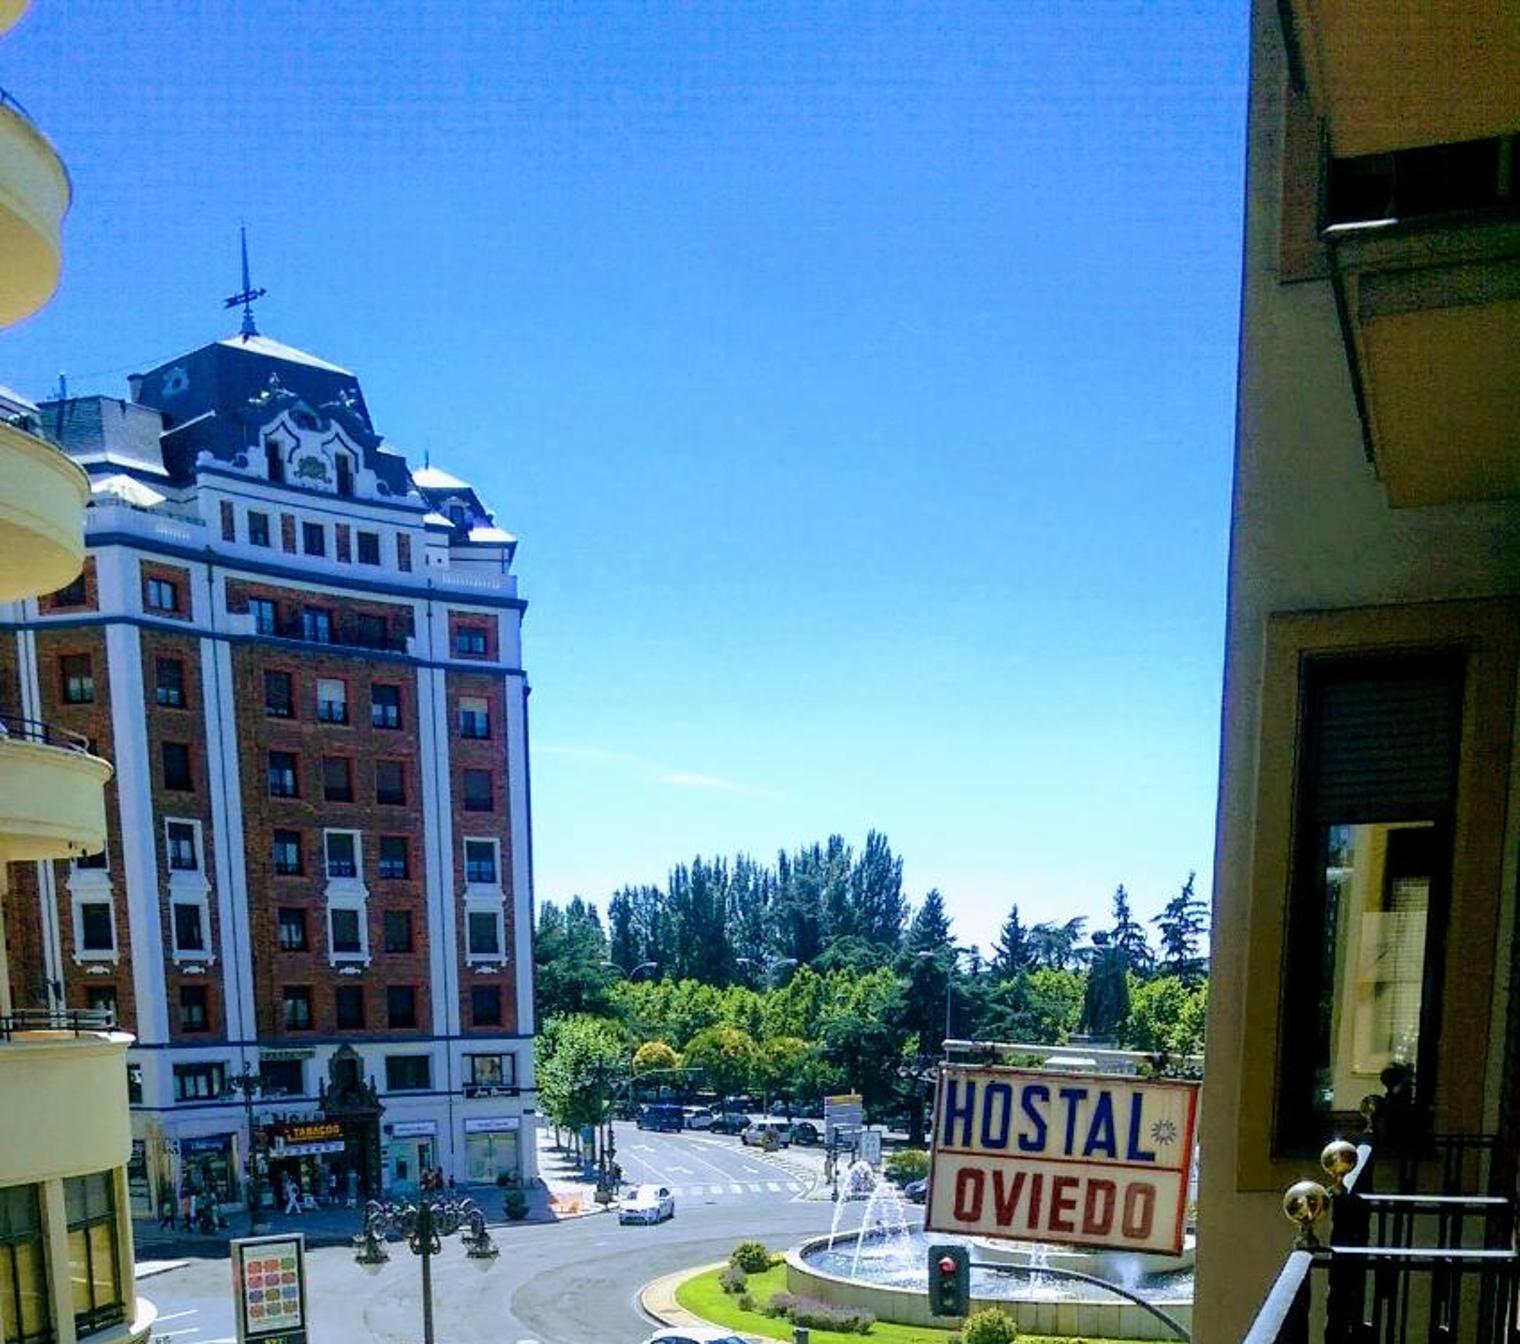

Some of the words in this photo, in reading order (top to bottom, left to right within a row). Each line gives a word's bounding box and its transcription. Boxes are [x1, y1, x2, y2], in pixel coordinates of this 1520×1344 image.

[293, 1124, 340, 1137] TABACOS
[943, 1079, 1156, 1163] HOSTAL
[952, 1167, 1157, 1240] OVIEDO
